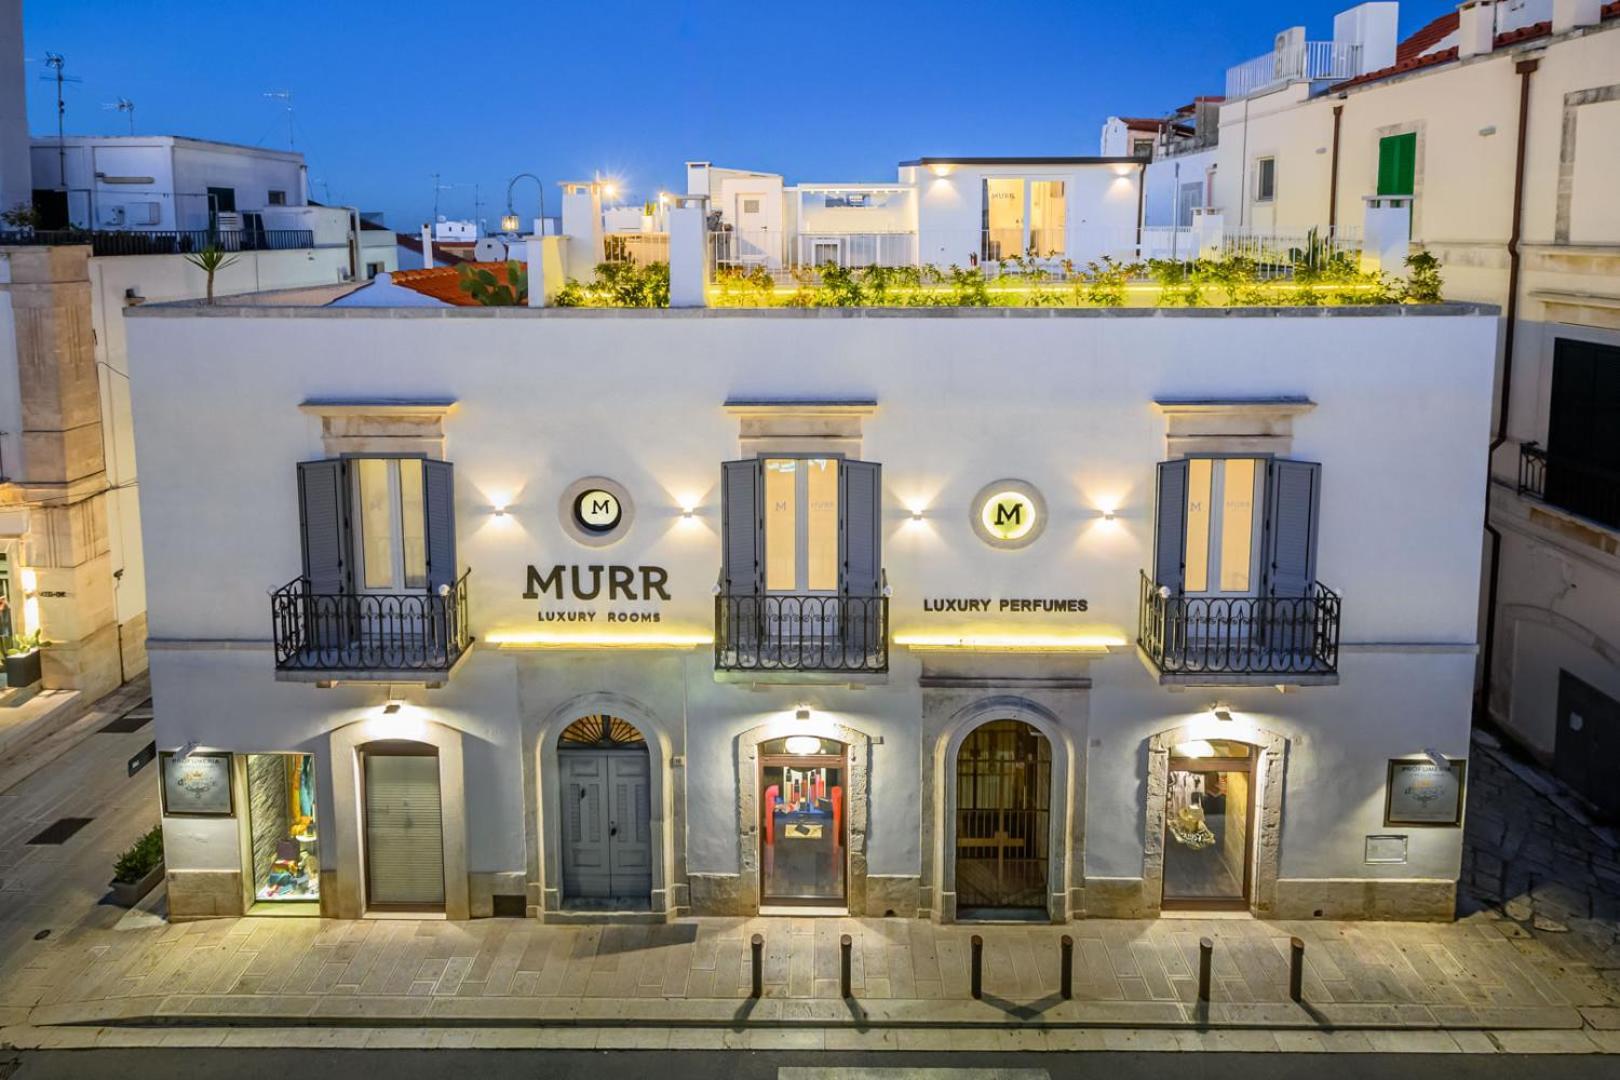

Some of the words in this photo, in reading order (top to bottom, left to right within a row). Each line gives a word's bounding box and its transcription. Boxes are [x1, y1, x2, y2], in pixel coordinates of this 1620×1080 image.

[591, 500, 609, 514] M
[994, 502, 1023, 525] M
[523, 565, 671, 600] MURR
[923, 599, 991, 612] LUXURY
[999, 599, 1088, 612] PERFUMES
[538, 611, 597, 622] LUXURY
[608, 612, 661, 623] ROOMS
